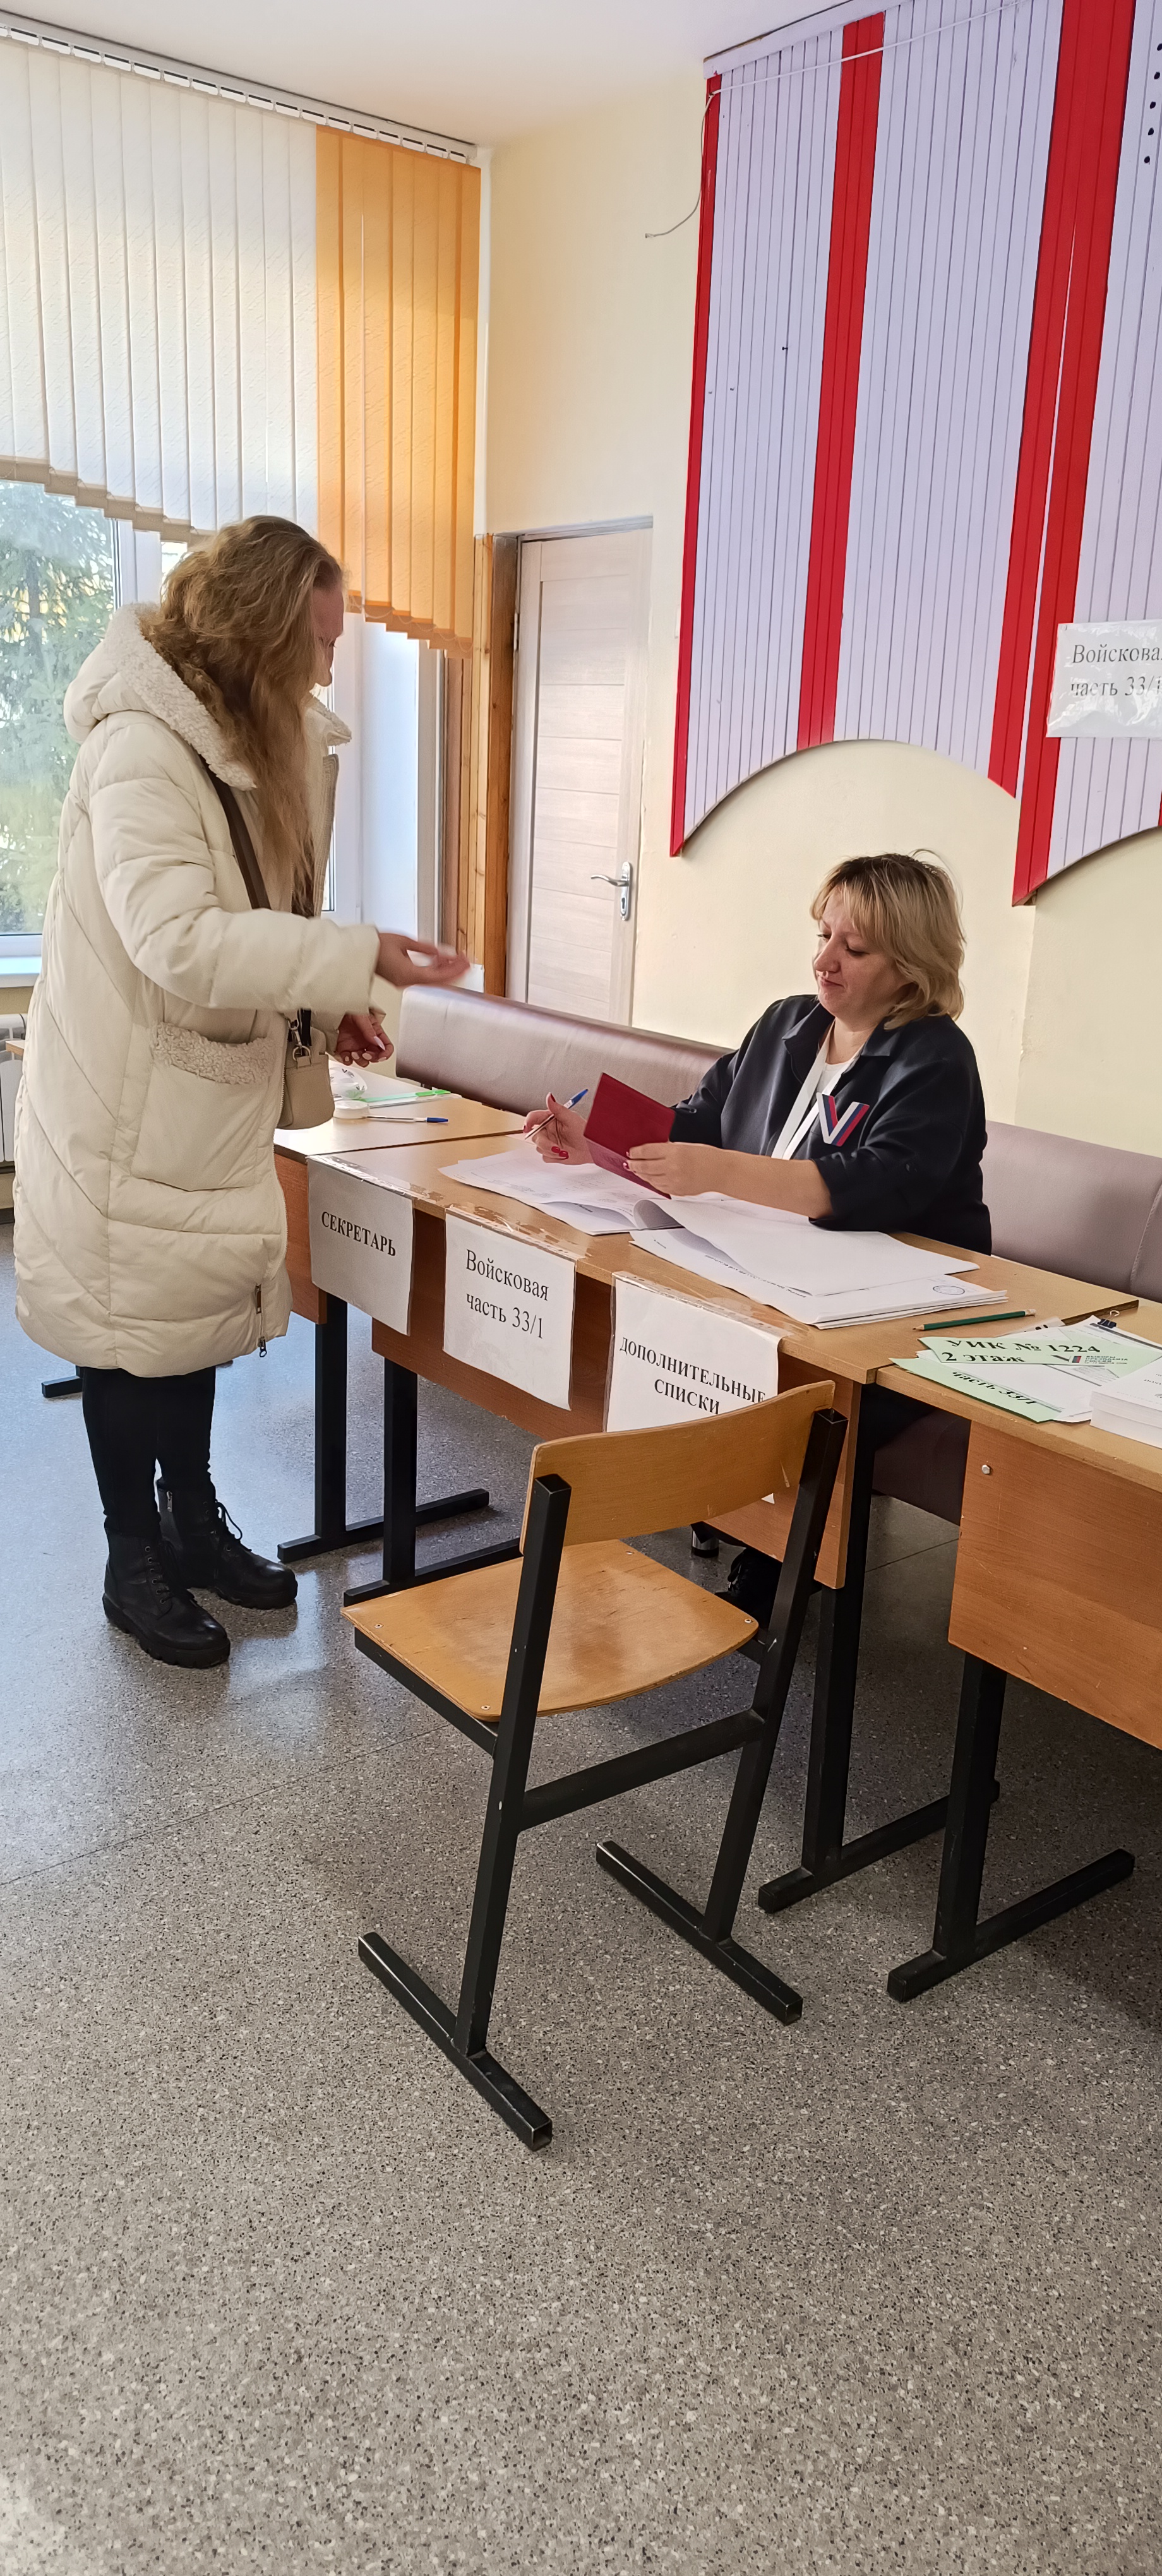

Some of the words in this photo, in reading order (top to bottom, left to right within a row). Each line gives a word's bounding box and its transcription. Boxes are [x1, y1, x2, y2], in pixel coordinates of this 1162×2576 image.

[1073, 643, 1162, 664] Войскова
[1071, 683, 1118, 696] часть
[321, 1211, 397, 1257] СЕКРЕТАРЬ
[466, 1249, 549, 1301] Войсковая
[466, 1293, 506, 1323] часть
[512, 1307, 543, 1339] 33/1
[942, 1352, 957, 1362] 2
[963, 1354, 1026, 1363] этаж
[946, 1340, 1008, 1350] УИК
[1012, 1342, 1042, 1351] №
[1046, 1344, 1101, 1352] 1224
[620, 1337, 766, 1404] ДОПОЛНИТЕЛЬНЫЕ
[952, 1371, 995, 1390] часть
[654, 1379, 720, 1415] СПИСКИ
